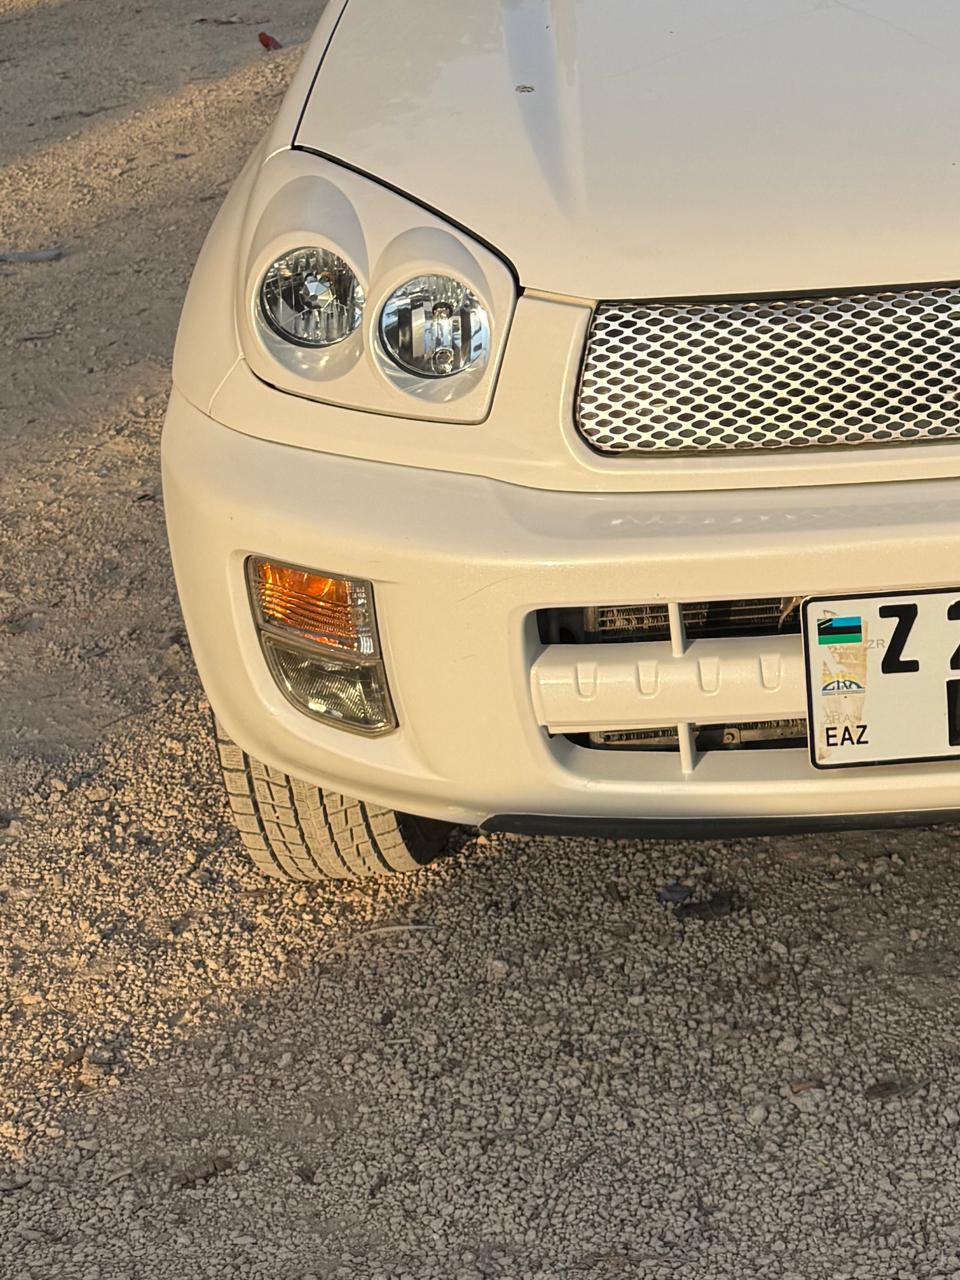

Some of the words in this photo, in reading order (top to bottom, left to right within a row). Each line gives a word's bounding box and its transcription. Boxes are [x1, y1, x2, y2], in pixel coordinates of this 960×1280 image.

[868, 638, 887, 649] ZR
[879, 603, 919, 674] Z
[825, 724, 869, 747] EAZ
